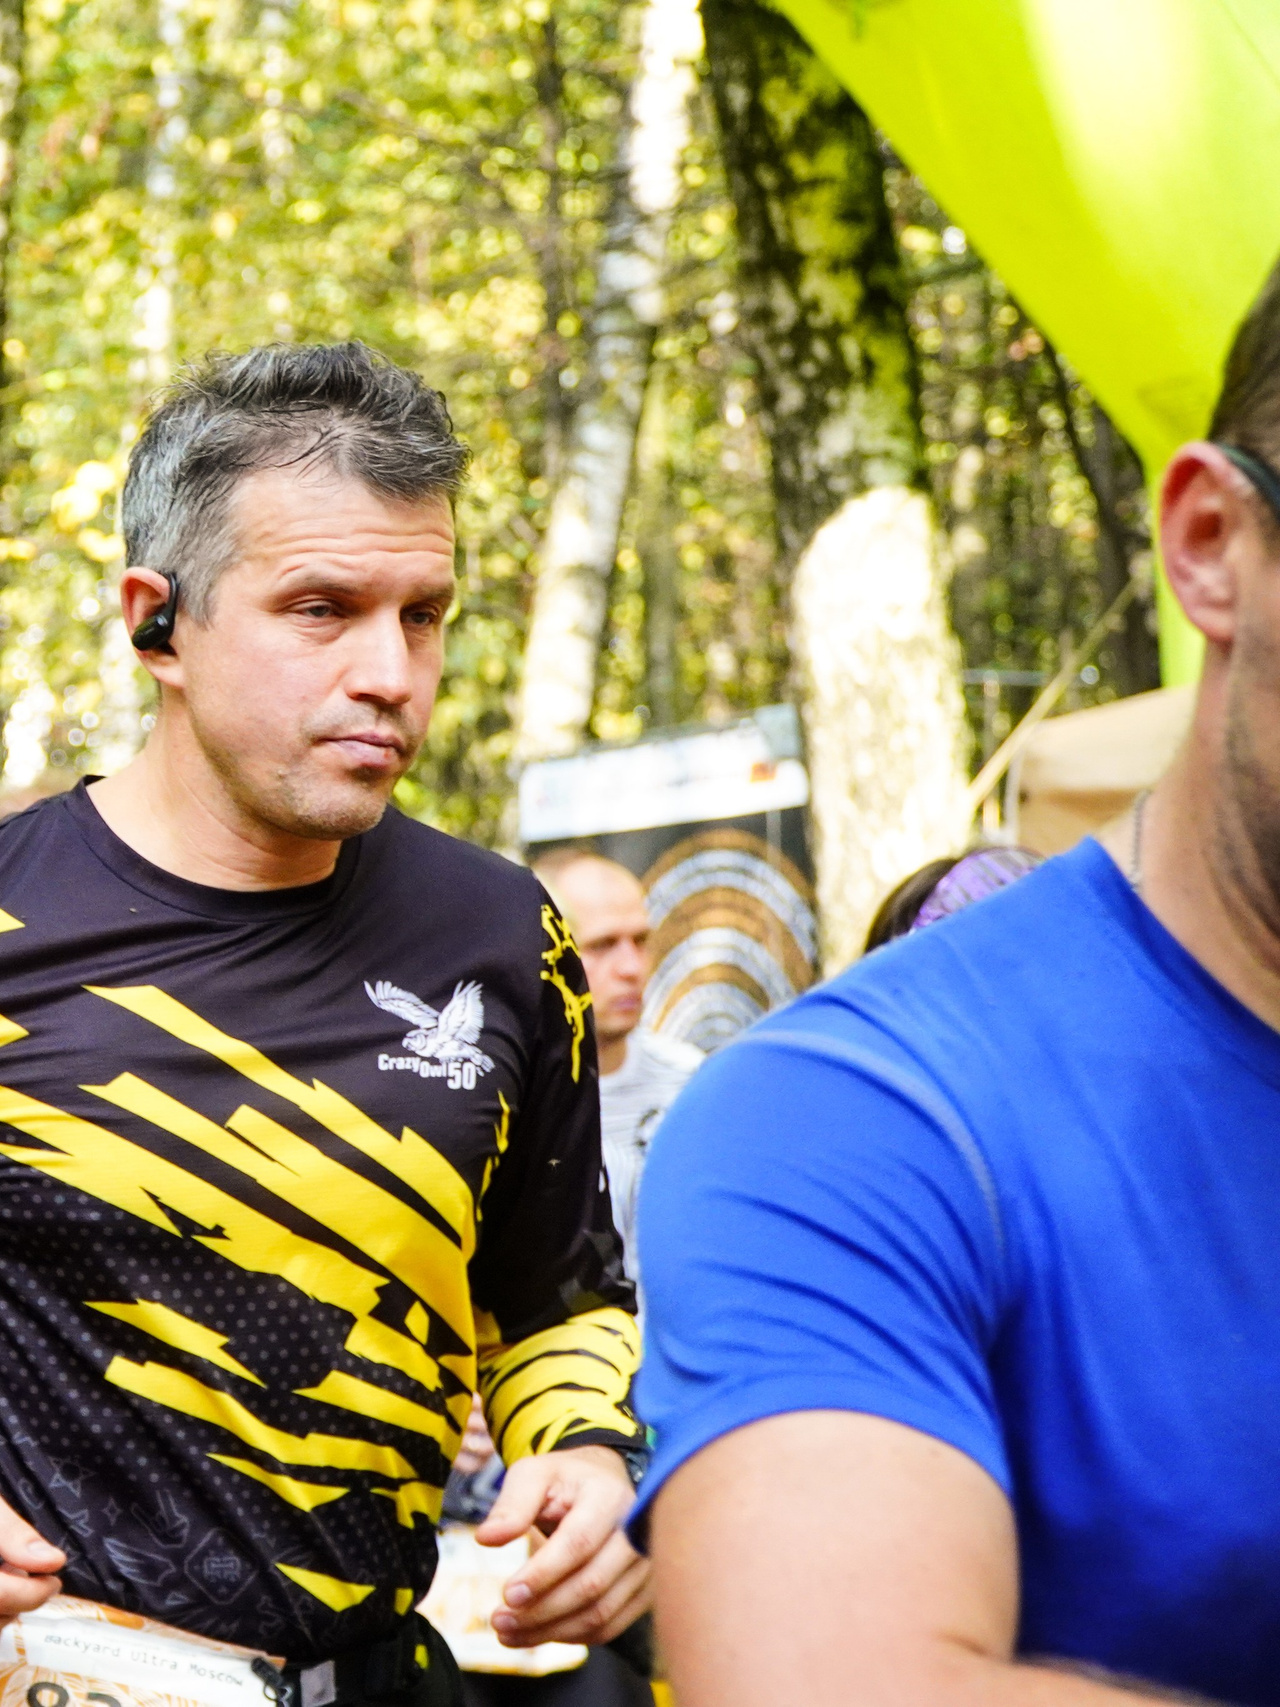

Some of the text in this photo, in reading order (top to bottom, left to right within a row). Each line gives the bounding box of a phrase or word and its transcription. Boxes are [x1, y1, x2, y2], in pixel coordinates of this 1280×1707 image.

[447, 1061, 478, 1091] 50
[43, 1633, 244, 1687] Backyard Ultra Moscow
